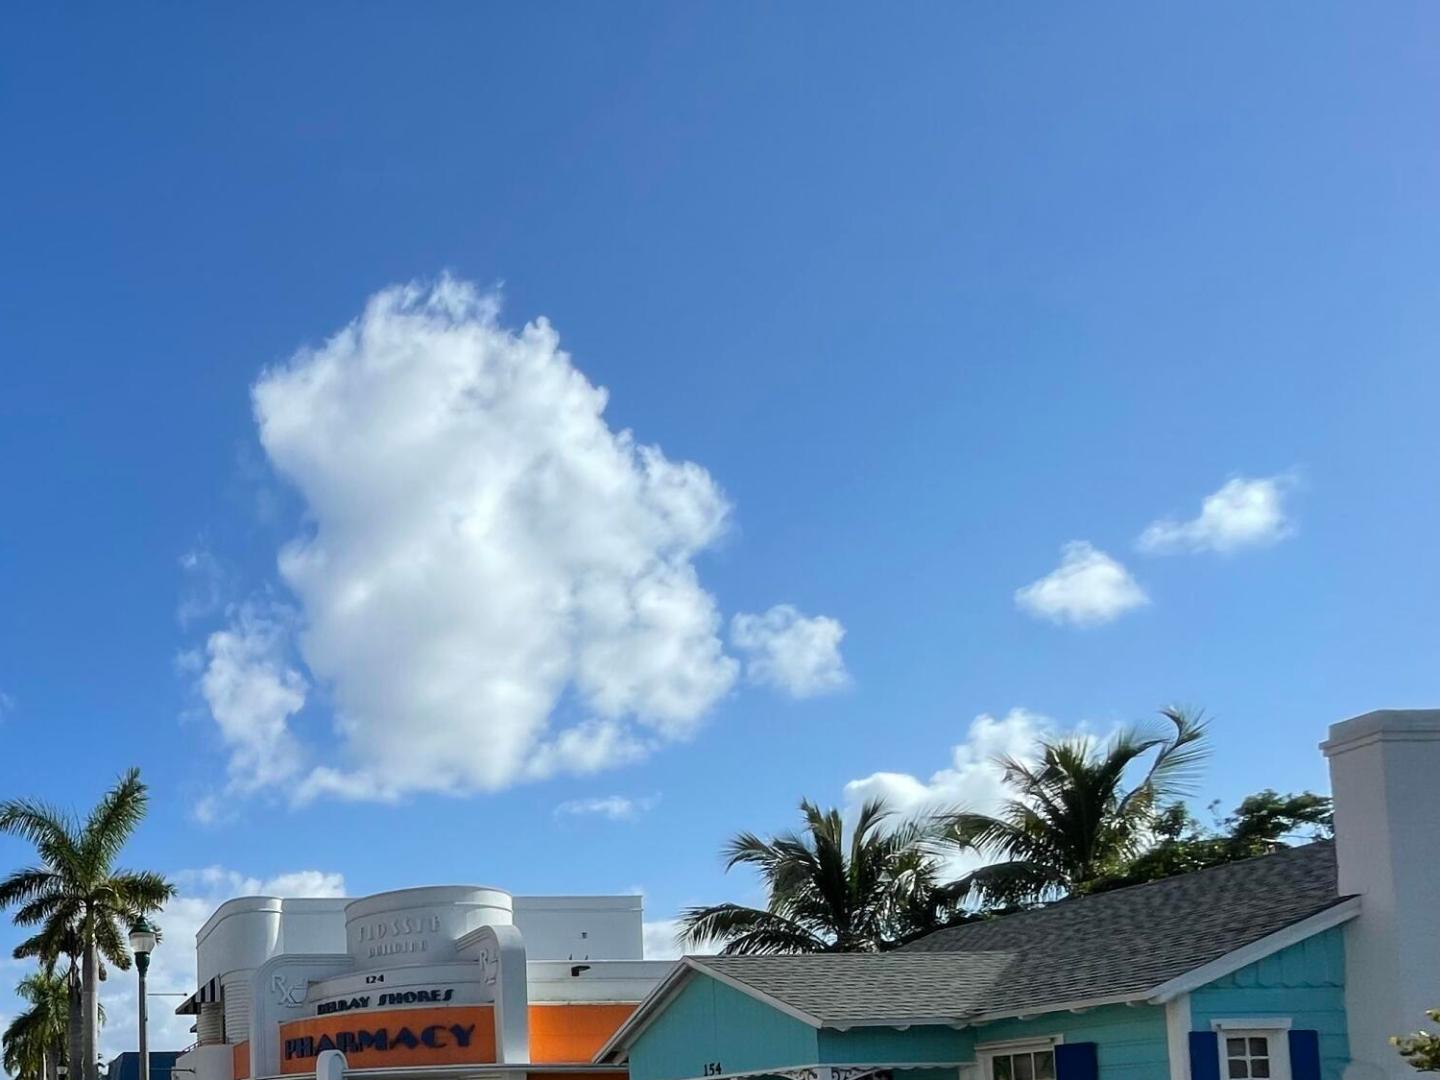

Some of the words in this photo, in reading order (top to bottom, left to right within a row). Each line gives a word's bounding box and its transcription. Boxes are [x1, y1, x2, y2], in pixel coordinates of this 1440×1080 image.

[365, 974, 385, 985] 124
[316, 996, 370, 1016] DELRAY
[377, 989, 455, 1007] SHORES
[284, 1023, 476, 1060] PHARMACY
[702, 1062, 723, 1077] 154
